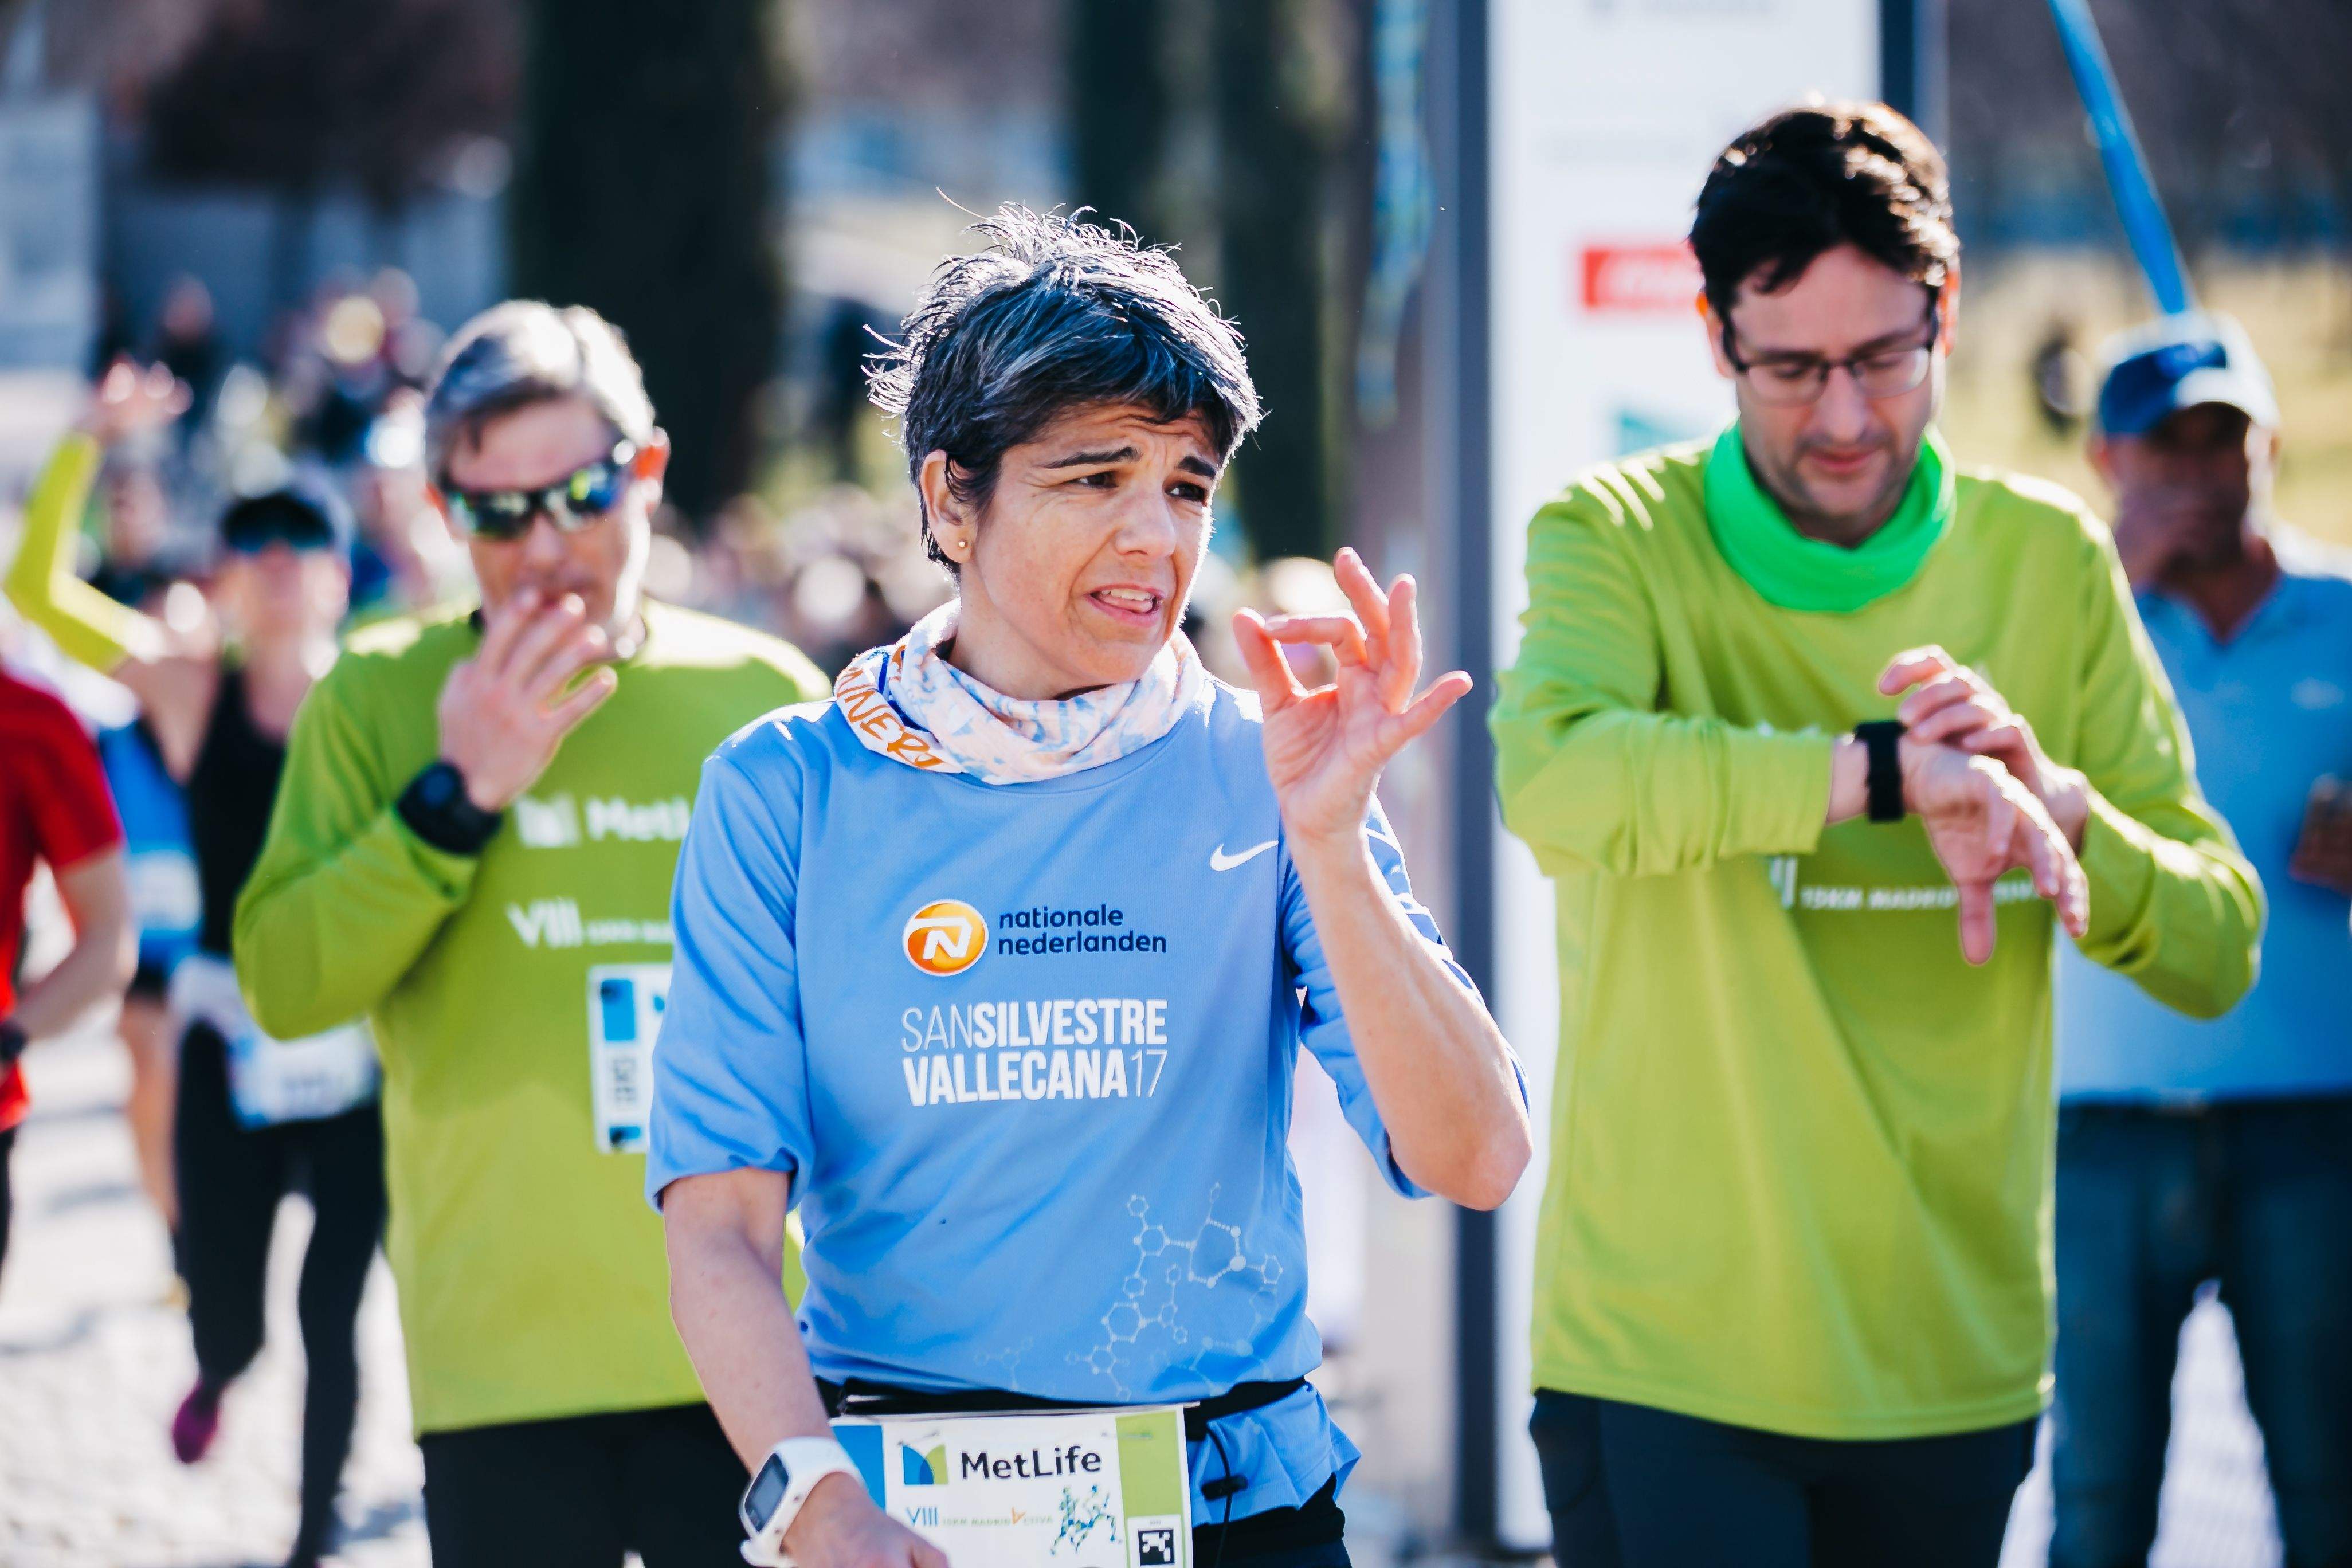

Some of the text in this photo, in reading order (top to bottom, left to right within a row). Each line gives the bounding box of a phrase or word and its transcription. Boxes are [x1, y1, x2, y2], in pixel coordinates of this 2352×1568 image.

[999, 904, 1124, 929] nationale
[998, 930, 1167, 955] nederlanden
[961, 1445, 1101, 1479] MetLife
[905, 1506, 938, 1526] VIII
